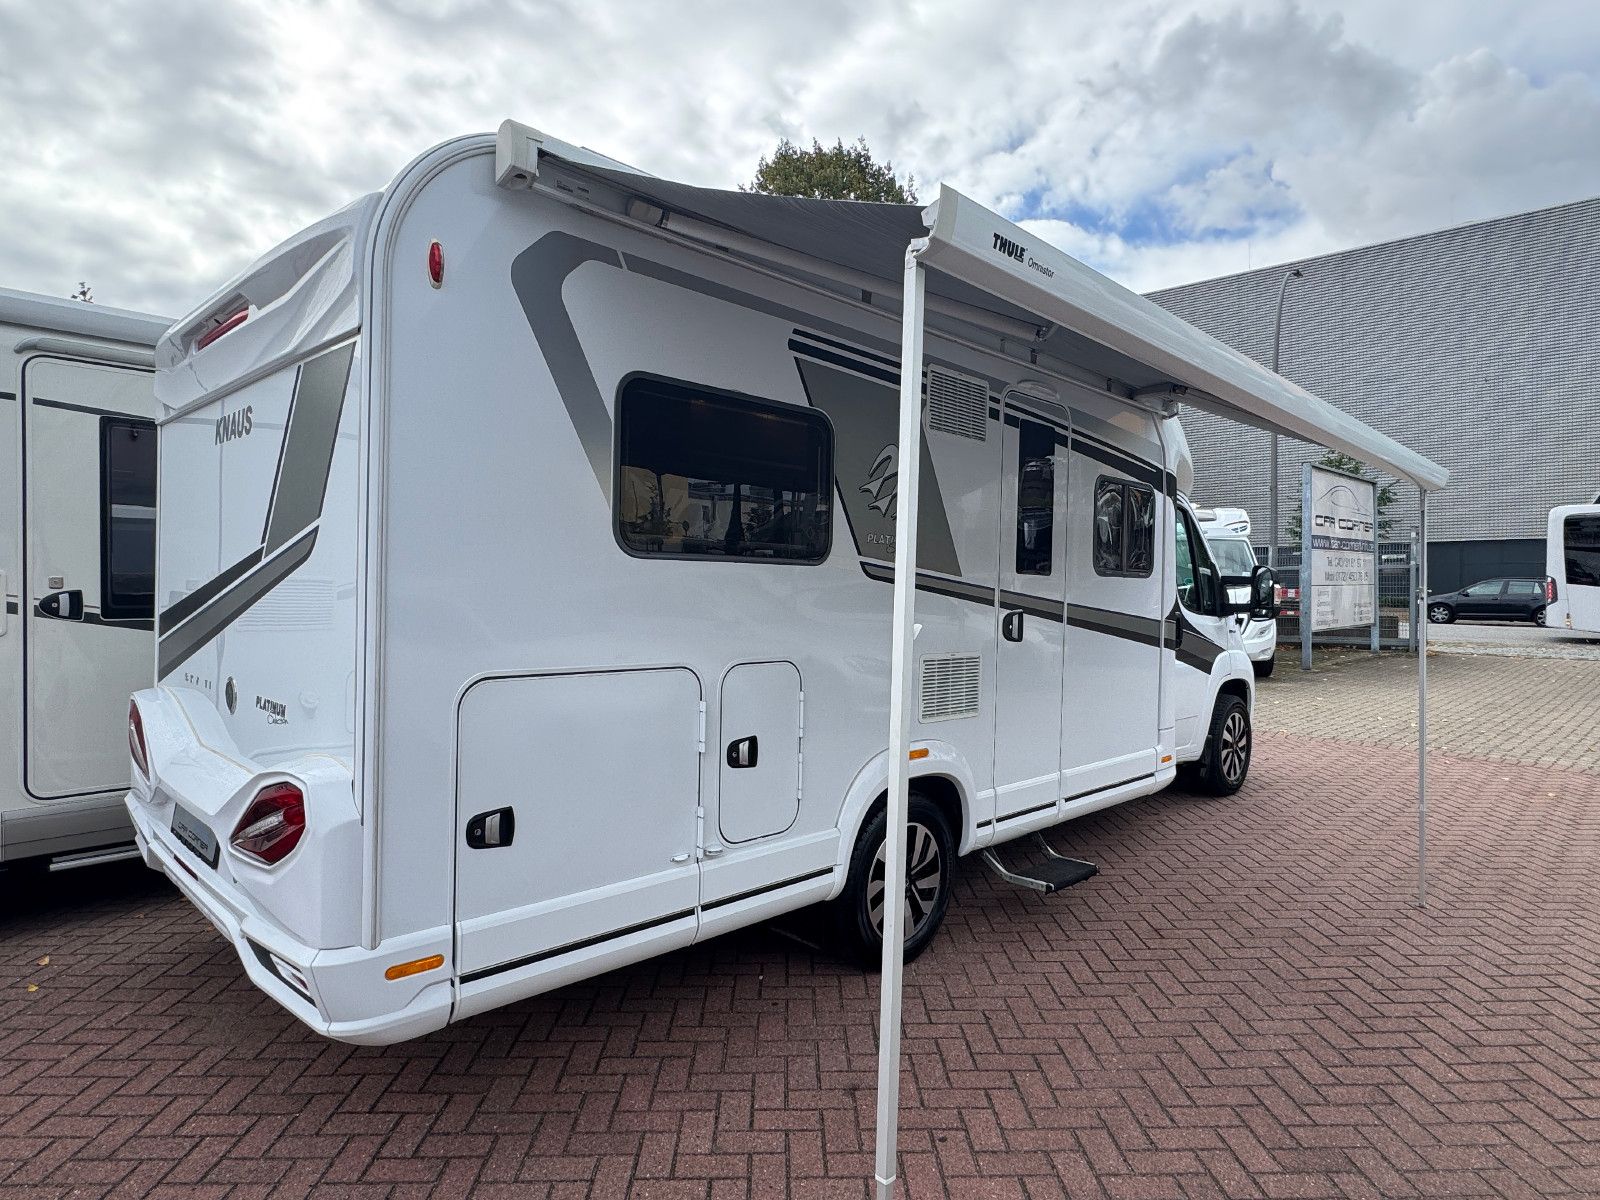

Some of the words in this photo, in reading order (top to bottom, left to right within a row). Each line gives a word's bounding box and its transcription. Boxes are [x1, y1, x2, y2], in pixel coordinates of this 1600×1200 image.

[992, 232, 1025, 263] THULE
[1028, 257, 1055, 279] Omnistor
[214, 405, 253, 445] KNAUS
[867, 533, 896, 544] PLATI
[255, 695, 287, 718] PLATINUM
